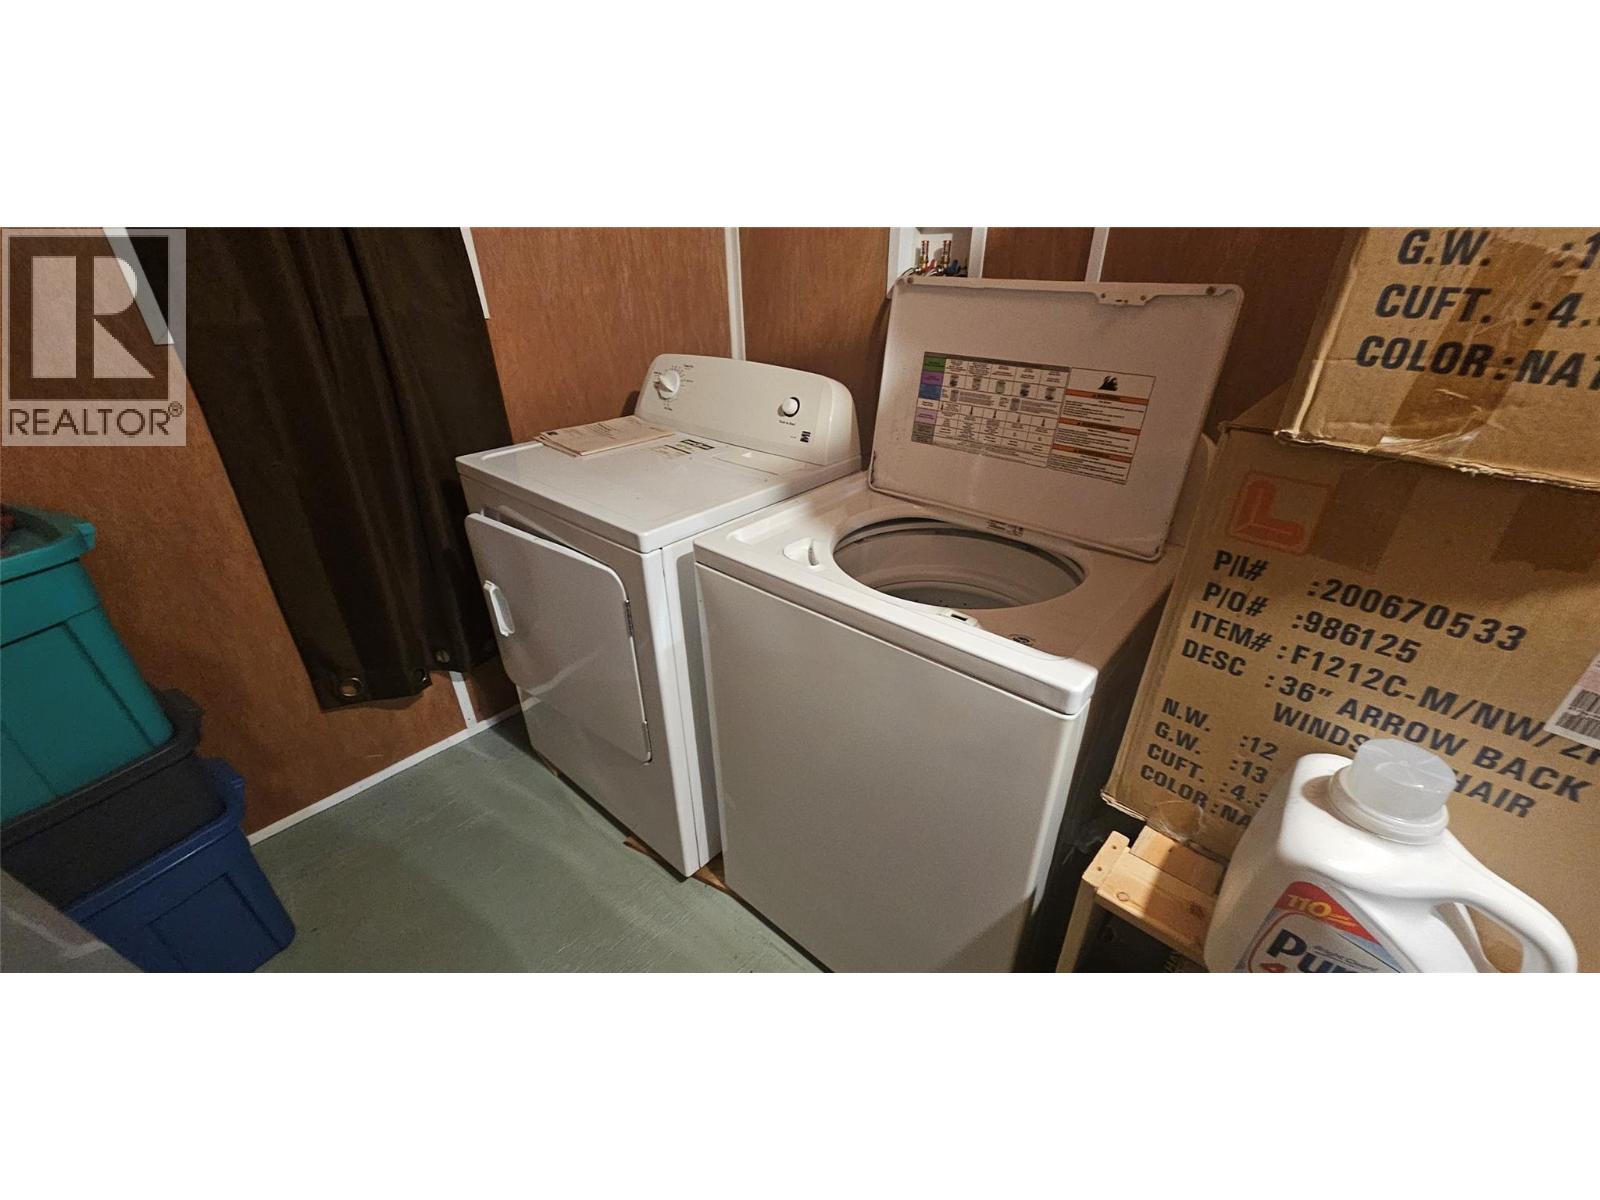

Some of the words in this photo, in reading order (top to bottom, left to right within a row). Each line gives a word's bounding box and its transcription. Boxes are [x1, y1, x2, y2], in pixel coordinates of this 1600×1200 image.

[1397, 229, 1492, 266] G.W.
[1375, 283, 1492, 324] CUFT.
[1523, 292, 1600, 327] :4.
[1190, 610, 1273, 652] ITEM#
[1202, 582, 1269, 617] P/O#
[1291, 611, 1422, 663] :986125
[1213, 550, 1269, 581] P/I#
[1307, 578, 1527, 651] :200670533
[1161, 697, 1211, 733] N.W.
[1239, 735, 1279, 761] :12
[1181, 638, 1246, 676] DESC
[1335, 698, 1469, 757] ARROW
[1471, 745, 1592, 803] BACK
[1147, 743, 1206, 783] CUFT.
[1155, 721, 1201, 755] G.W.
[1229, 759, 1269, 784] :13
